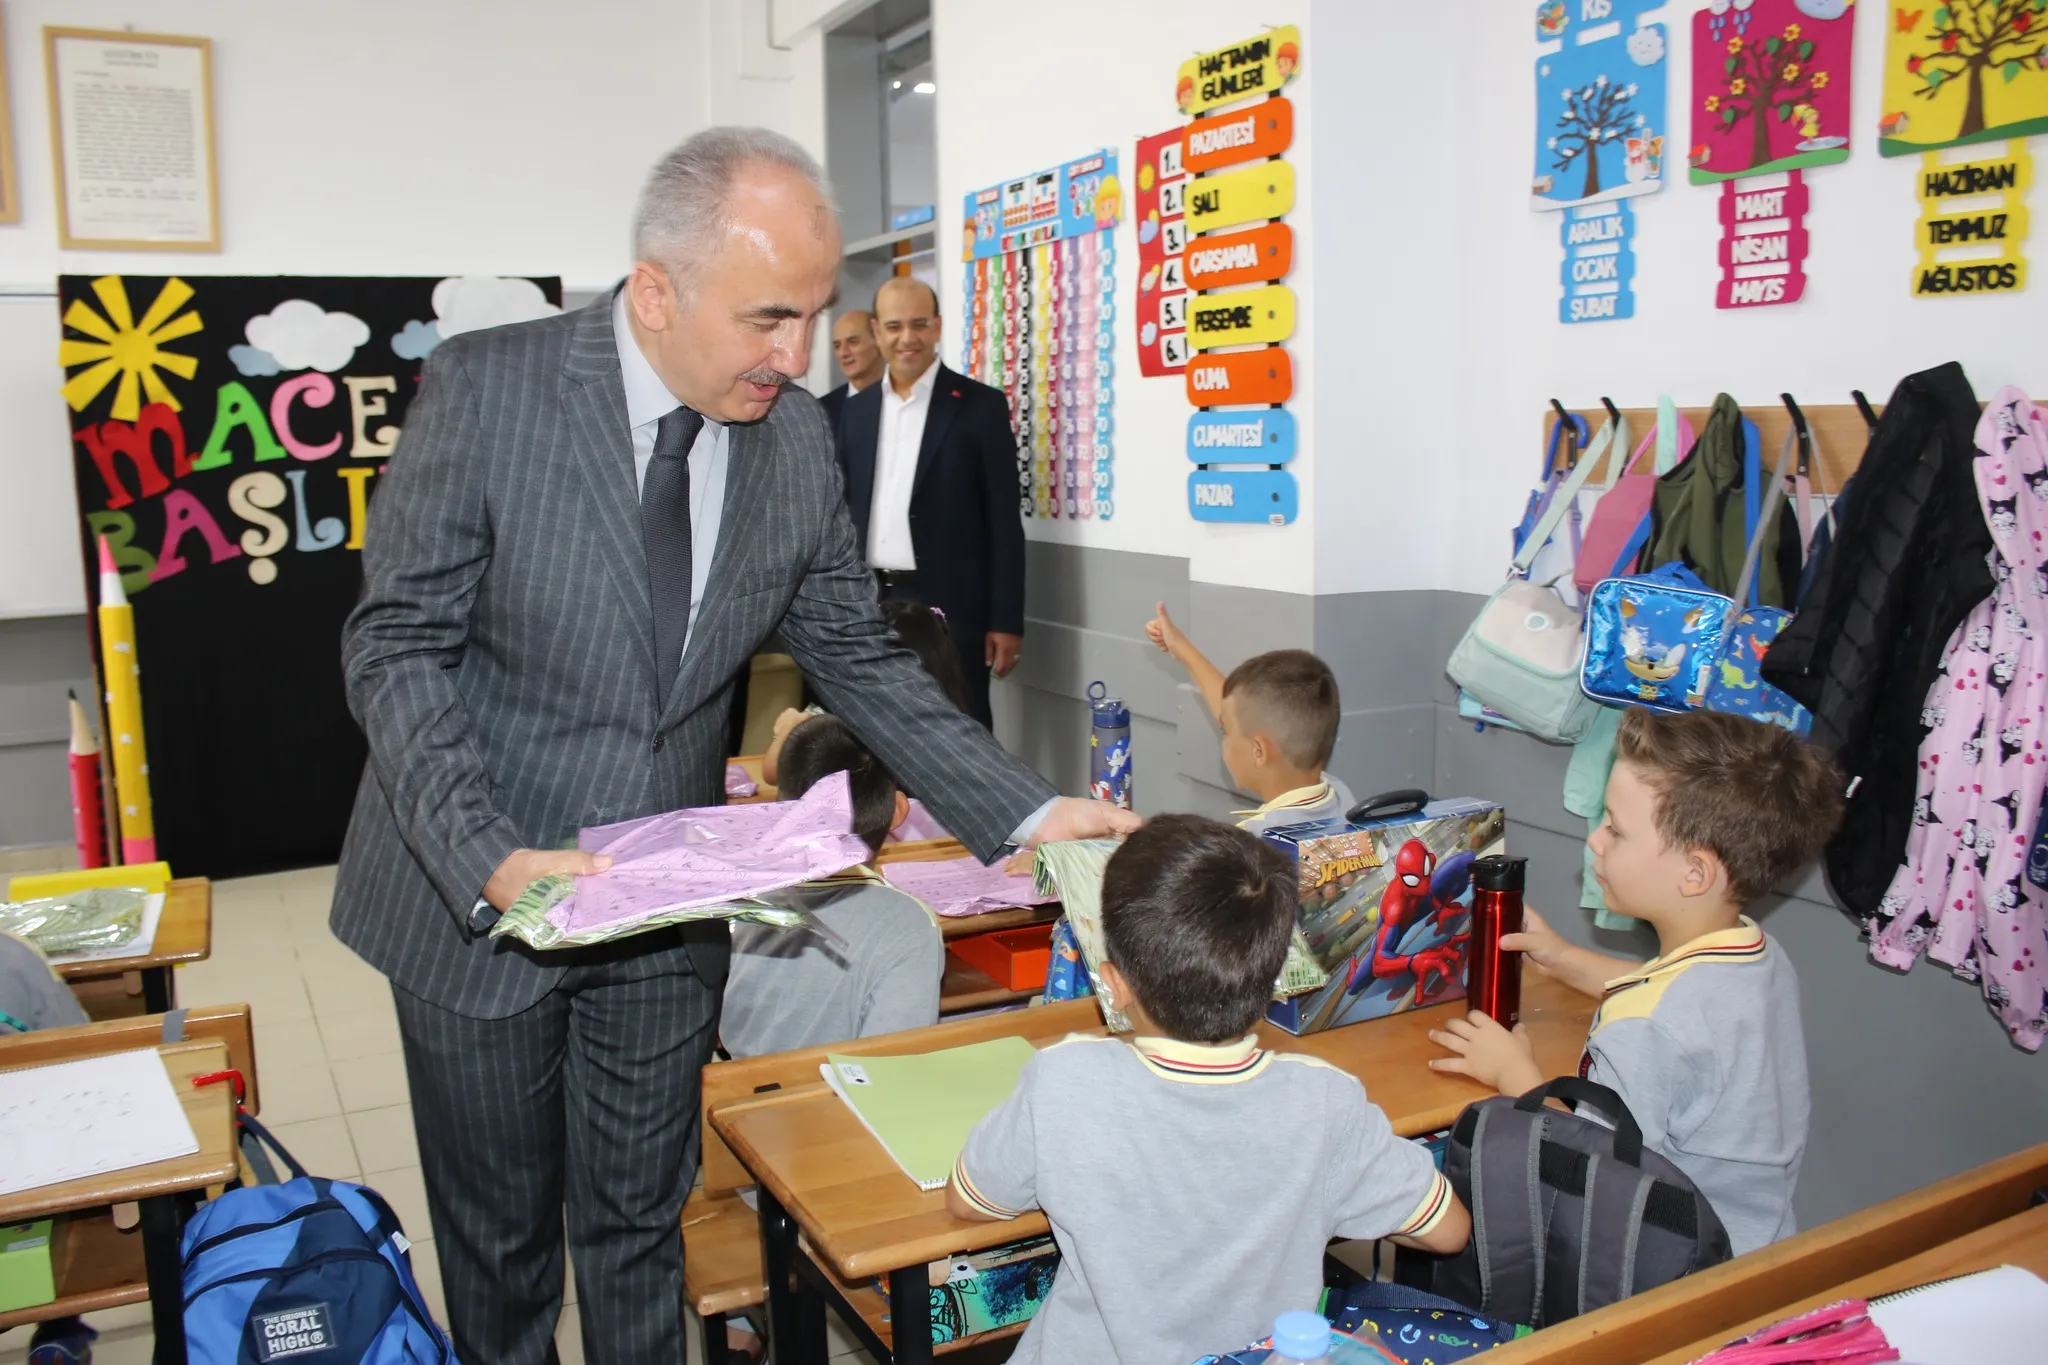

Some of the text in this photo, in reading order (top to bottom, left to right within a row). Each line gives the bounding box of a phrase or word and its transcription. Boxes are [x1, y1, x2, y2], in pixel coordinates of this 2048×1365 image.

[1198, 38, 1270, 78] HAFTANIN
[1189, 115, 1256, 156] PAZARTESİ
[1924, 163, 2017, 198] HAZİRAN
[1192, 189, 1220, 216] SALI
[1735, 190, 1787, 220] MART
[1567, 216, 1624, 245] ARALIK
[1927, 213, 2008, 244] TEMMUZ
[1731, 234, 1788, 264] NİSAN
[1571, 256, 1618, 282] OCAK
[1917, 262, 2017, 295] AĞUSTOS
[1730, 277, 1787, 304] MAYIS
[1569, 295, 1619, 321] ŞUBAT
[1192, 366, 1231, 391] CUMA
[74, 370, 422, 510] MACE
[1192, 418, 1264, 448] CUMARTESİ
[1194, 483, 1235, 507] PAZAR
[85, 464, 388, 596] BAŞLI
[1315, 854, 1384, 889] SPIDER-MAN
[262, 1308, 320, 1325] THE ORIGINAL
[264, 1316, 323, 1338] CORAL
